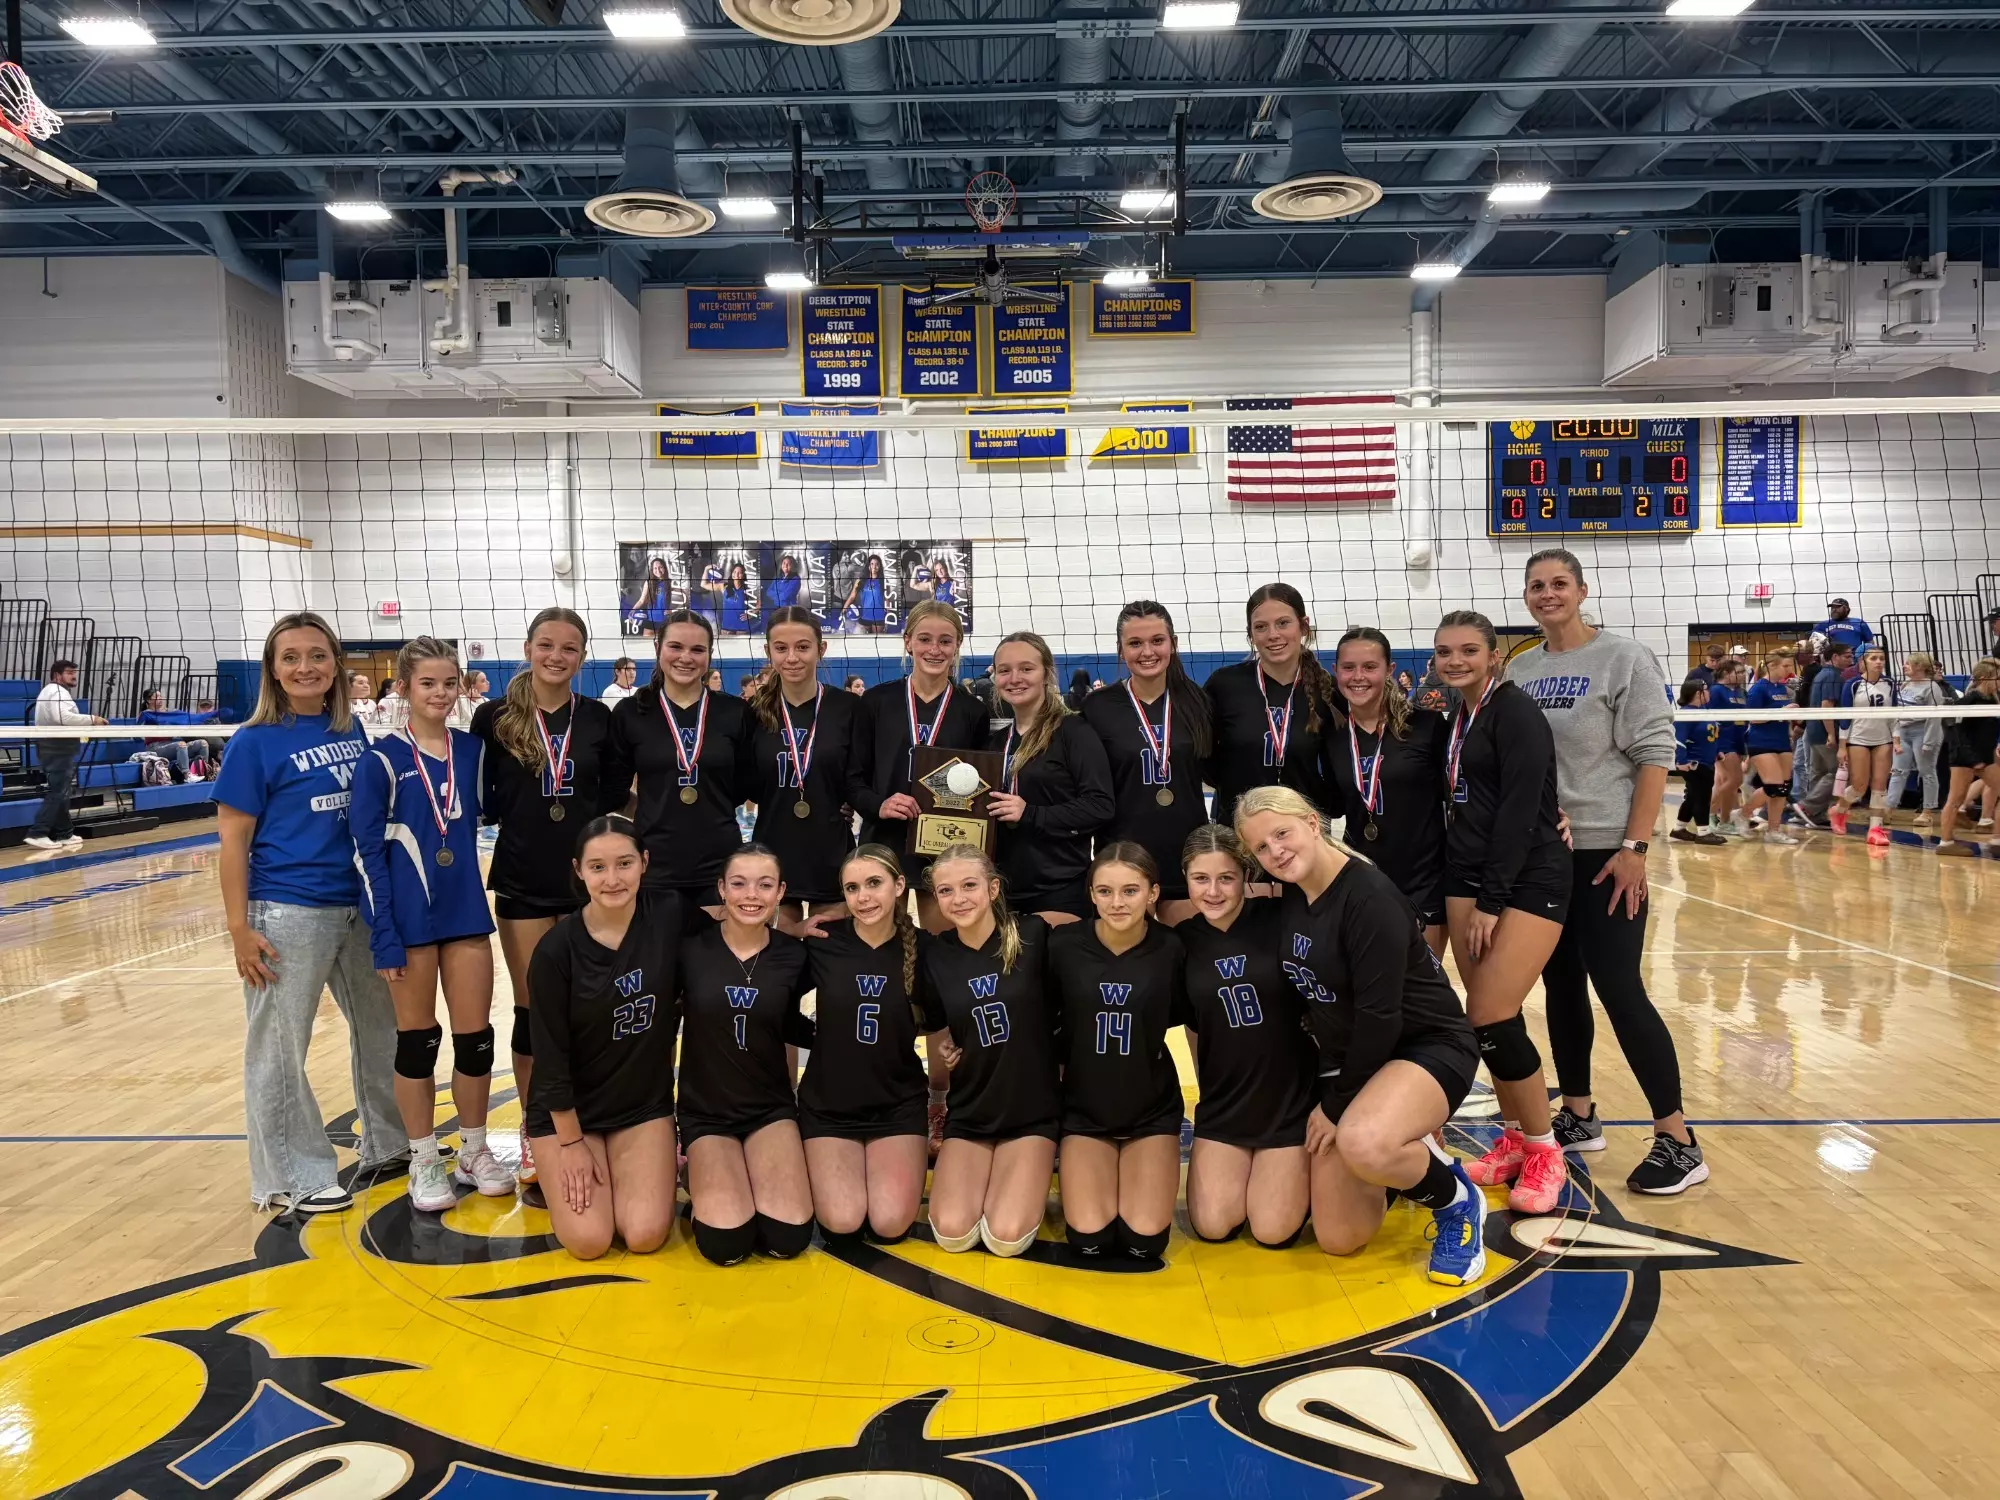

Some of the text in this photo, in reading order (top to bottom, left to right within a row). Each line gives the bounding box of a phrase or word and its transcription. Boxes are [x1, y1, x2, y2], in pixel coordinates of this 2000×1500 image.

[717, 292, 757, 300] WRESTLING
[809, 296, 871, 305] DEREK TIPTON
[699, 302, 750, 311] INTER-COUNTY
[914, 306, 963, 317] WRESTLING
[1005, 304, 1057, 314] WRESTLING
[1104, 299, 1181, 312] CHAMPIONS
[717, 313, 757, 321] CHAMPIONS
[815, 308, 866, 317] WRESTLING
[827, 321, 854, 330] STATE
[925, 319, 952, 328] STATE
[1018, 317, 1045, 326] STATE
[807, 332, 875, 345] CHAMPION
[906, 330, 971, 342] CHAMPION
[998, 328, 1065, 341] CHAMPION
[835, 350, 845, 358] AA
[1001, 346, 1025, 354] CLASS
[1026, 346, 1036, 354] AA
[1051, 345, 1063, 353] LB.
[1008, 356, 1040, 364] RECORD:
[823, 373, 861, 388] 1999
[920, 371, 959, 385] 2002
[1013, 369, 1052, 384] 2005
[1753, 416, 1793, 425] WIN CLUB
[979, 427, 1056, 439] CHAMPIONS
[1652, 423, 1685, 436] MILK
[810, 439, 850, 448] CHAMPIONS
[1507, 443, 1542, 455] HOME
[1646, 440, 1685, 453] GUEST
[1580, 448, 1609, 458] PERIOD
[1530, 459, 1545, 484] 0
[1596, 462, 1601, 479] 1
[1672, 456, 1686, 482] 0
[1502, 489, 1527, 497] FOULS
[1536, 487, 1558, 496] T.O.L.
[1568, 486, 1623, 496] PLAYER FOUL
[1632, 486, 1654, 495] T.O.L.
[1664, 486, 1688, 495] FOULS
[1511, 498, 1523, 518] 0
[1541, 498, 1553, 518] 2
[1636, 496, 1648, 516] 2
[1673, 495, 1685, 516] 0
[1501, 523, 1526, 531] SCORE
[1582, 521, 1608, 530] MATCH
[1663, 520, 1689, 529] SCORE
[743, 558, 758, 618] MALIA
[810, 555, 827, 619] ALICIA
[883, 548, 898, 626] DESTINY
[1755, 585, 1770, 596] EXIT
[382, 603, 397, 615] EXIT
[624, 619, 640, 635] 16
[1537, 697, 1576, 709] BLERS
[1869, 694, 1884, 706] 12
[328, 761, 357, 790] W
[776, 751, 807, 788] 17
[316, 794, 350, 809] VOLLE
[1293, 932, 1312, 960] W
[1214, 954, 1246, 980] W
[614, 968, 643, 997] W
[856, 975, 887, 997] W
[968, 973, 999, 999] W
[724, 985, 758, 1008] W
[1099, 982, 1132, 1006] W
[1218, 983, 1263, 1028] 18
[613, 994, 656, 1040] 23
[857, 1003, 880, 1045] 6
[972, 1001, 1010, 1048] 13
[733, 1014, 748, 1050] 1
[1096, 1011, 1132, 1055] 14
